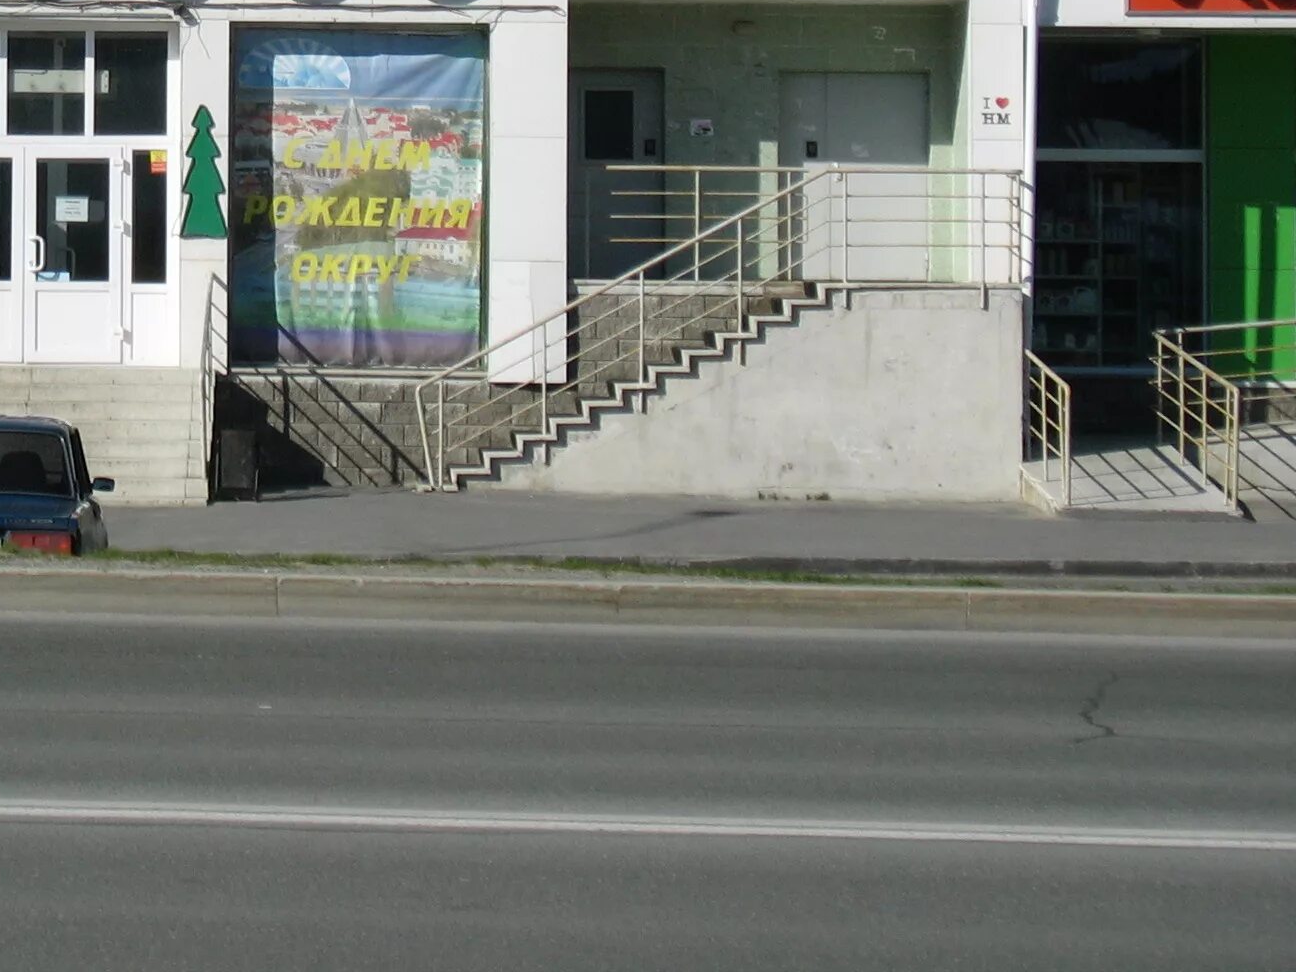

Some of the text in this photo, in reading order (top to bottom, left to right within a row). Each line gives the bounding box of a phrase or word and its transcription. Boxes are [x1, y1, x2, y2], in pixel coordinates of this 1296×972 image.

[282, 138, 433, 172] С ДНЕМ
[242, 194, 474, 229] РОЖДЕНИЯ
[290, 251, 423, 284] ОКРУГ
